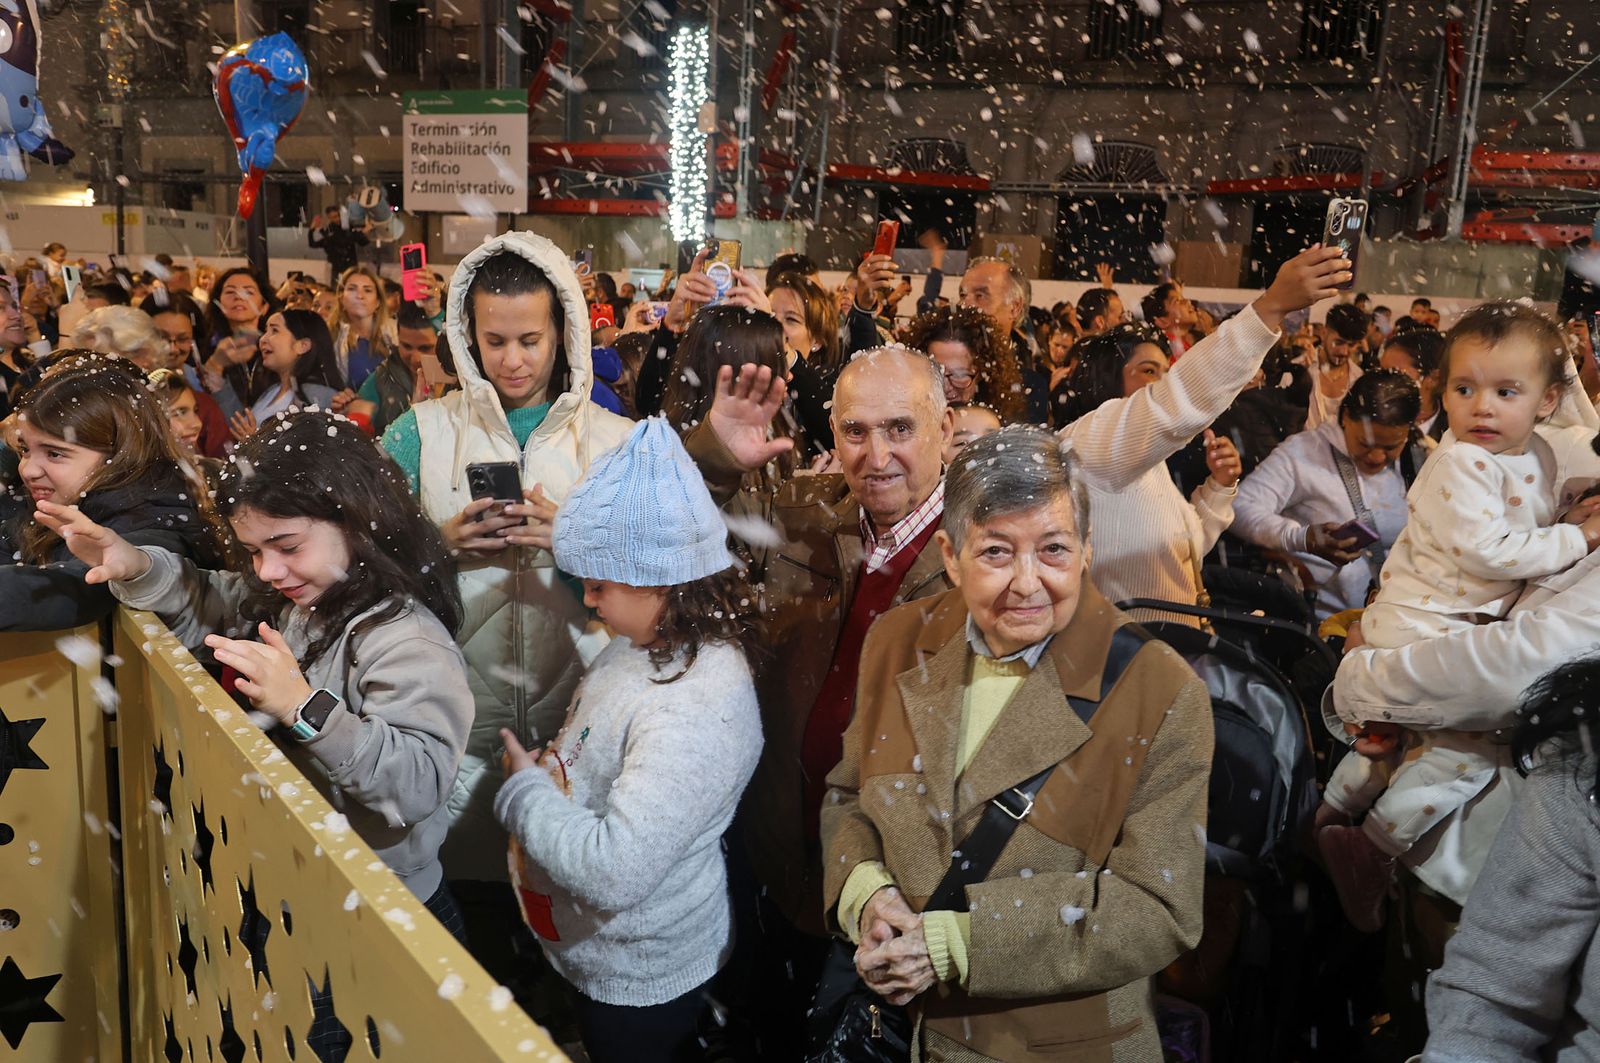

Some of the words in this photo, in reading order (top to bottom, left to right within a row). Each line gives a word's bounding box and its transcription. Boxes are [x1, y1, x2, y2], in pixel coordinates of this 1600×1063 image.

[411, 122, 497, 136] Terminción
[411, 141, 511, 155] Rehabilitación
[411, 160, 461, 175] Edificio
[411, 179, 515, 195] Administrativo
